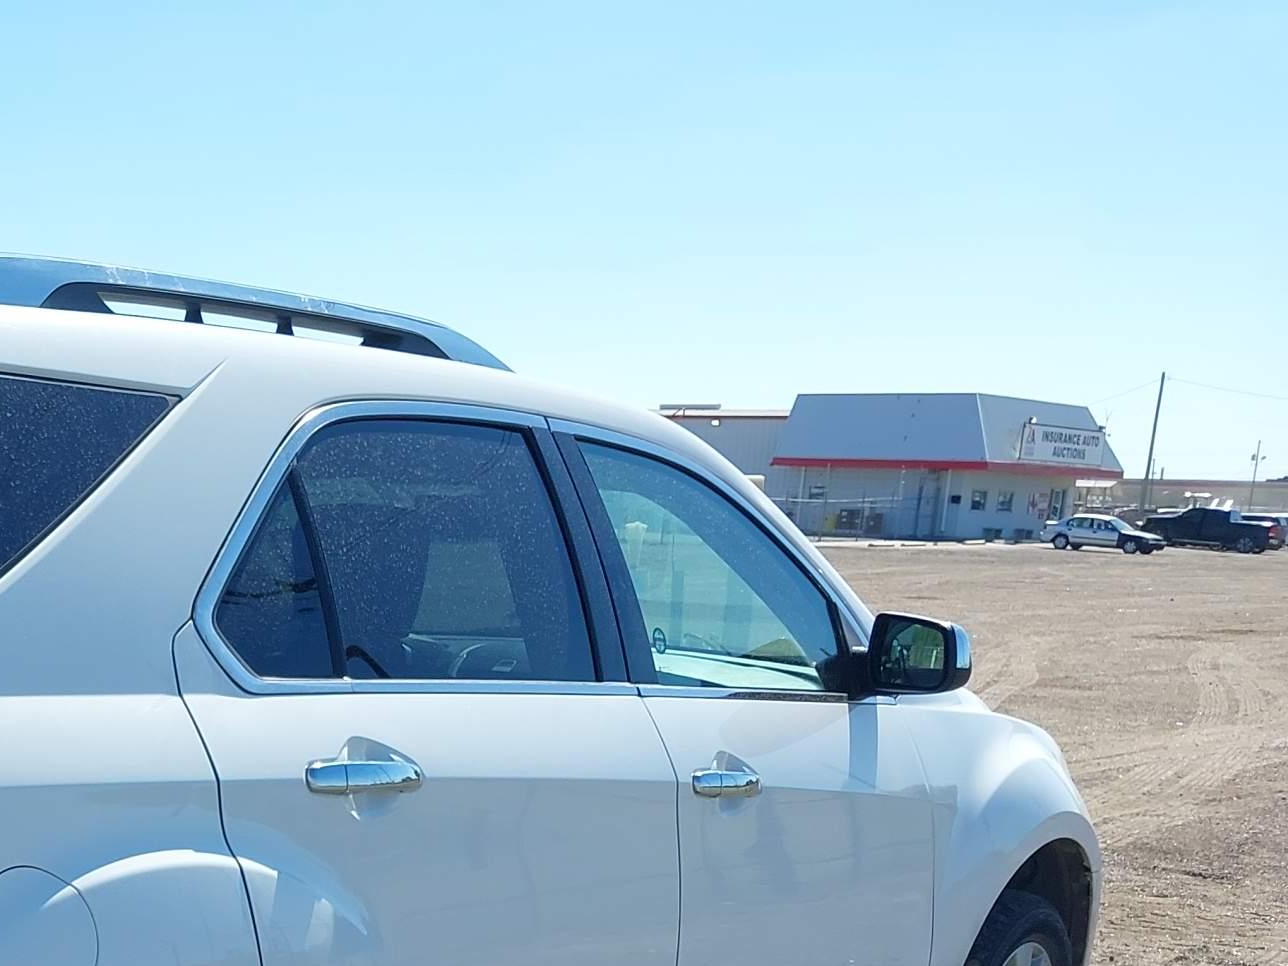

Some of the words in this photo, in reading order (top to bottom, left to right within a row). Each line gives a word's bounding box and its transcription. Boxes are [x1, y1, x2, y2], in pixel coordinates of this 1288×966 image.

[1042, 430, 1081, 446] INSURANCE
[1083, 434, 1100, 448] AUTO
[1052, 446, 1086, 460] AUCTIONS
